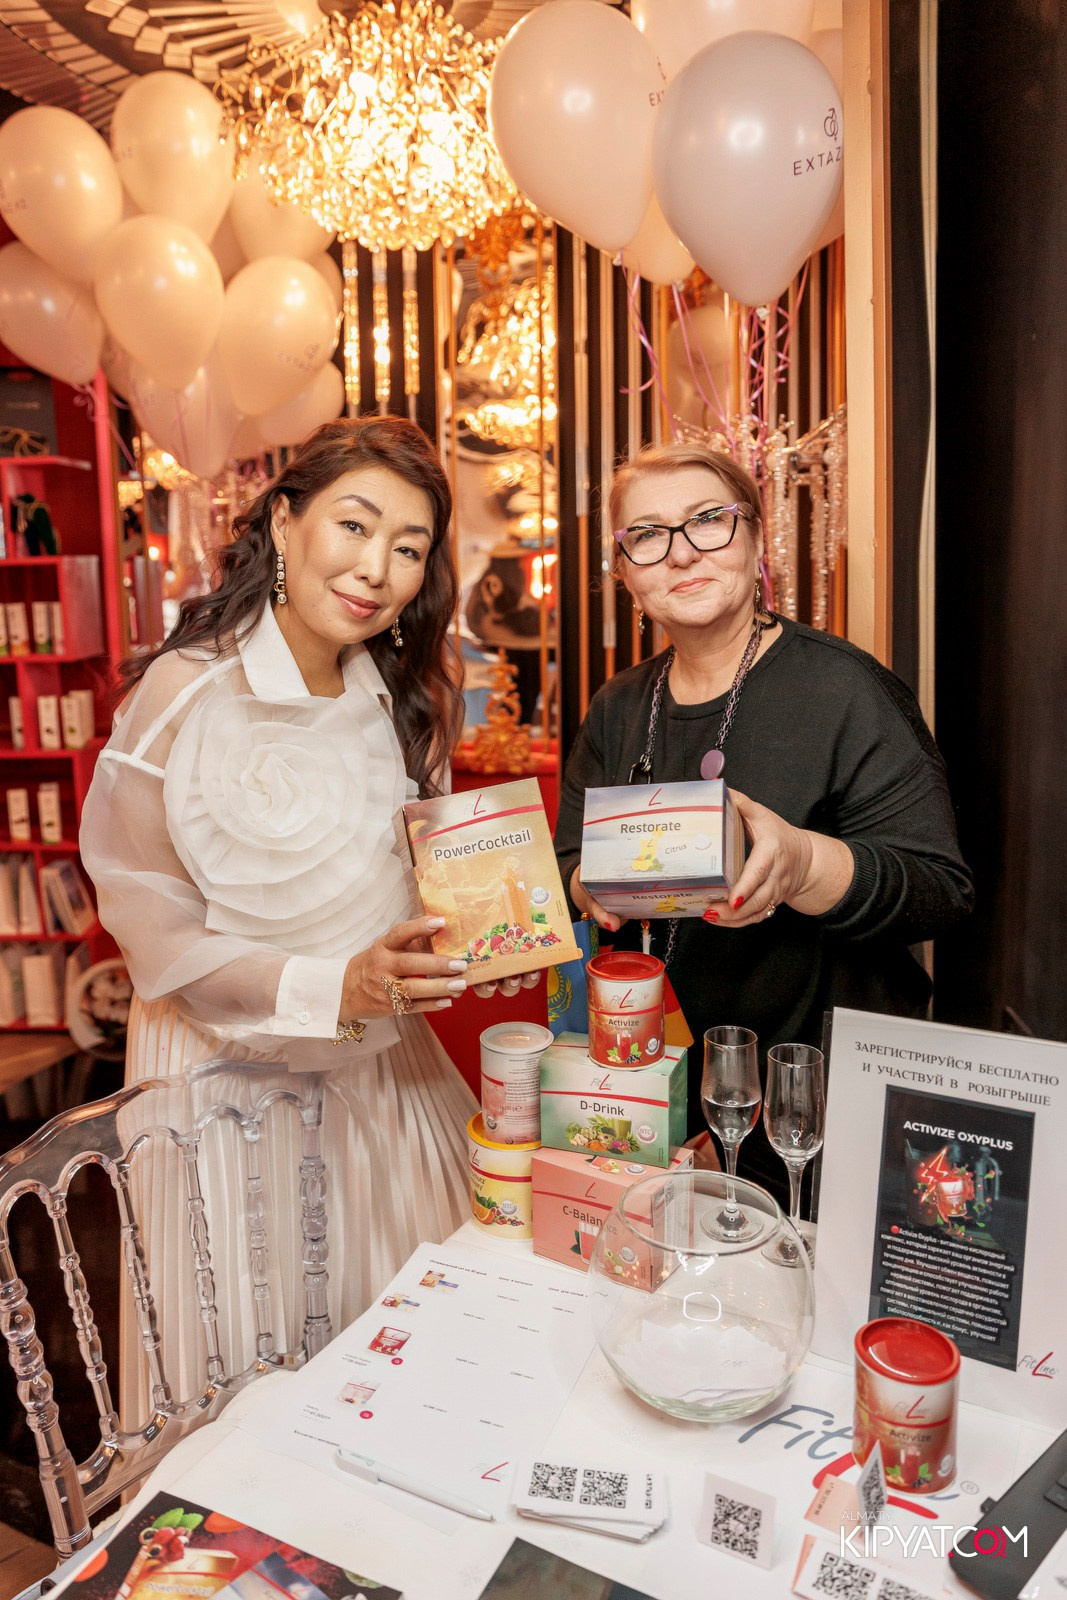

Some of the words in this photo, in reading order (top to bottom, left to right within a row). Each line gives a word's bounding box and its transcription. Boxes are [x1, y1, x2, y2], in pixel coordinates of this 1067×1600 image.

[793, 146, 844, 176] EXTAZ
[620, 821, 681, 834] Restorate
[434, 829, 532, 861] PowerCocktail
[665, 843, 687, 855] Citrus
[608, 1018, 640, 1027] Activize
[854, 1041, 972, 1071] ЗАРЕГИСТРИРУЙСЯ
[978, 1063, 1060, 1086] БЕСПЛАТНО
[591, 1073, 613, 1091] FitLine
[862, 1062, 871, 1072] И
[876, 1064, 944, 1086] УЧАСТВУЙ
[950, 1079, 958, 1089] В
[968, 1082, 1051, 1106] РОЗЫГРЫШЕ
[580, 1100, 625, 1116] D-Drink
[903, 1120, 955, 1139] ACTIVIZE
[957, 1131, 1014, 1151] OXYPLUS
[1018, 1351, 1057, 1379] FitLine
[889, 1428, 932, 1443] Activize
